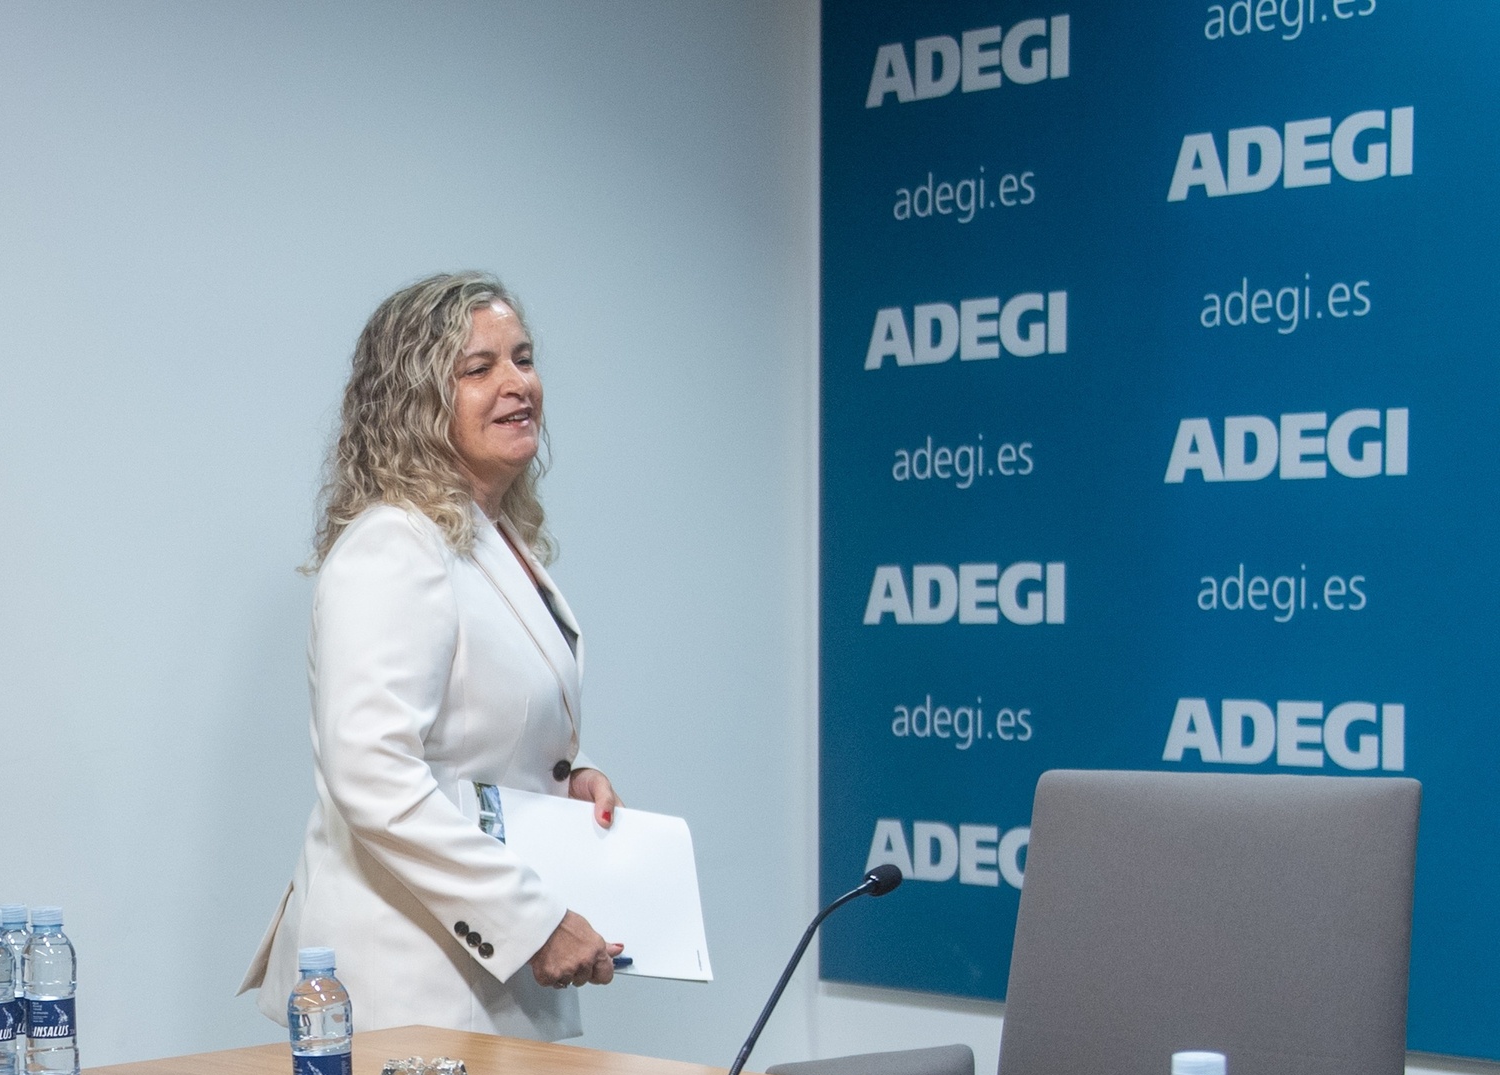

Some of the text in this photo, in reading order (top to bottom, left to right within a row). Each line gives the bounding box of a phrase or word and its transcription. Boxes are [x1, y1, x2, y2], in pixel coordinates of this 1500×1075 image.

[865, 13, 1071, 109] ADEGI
[1167, 105, 1415, 202] ADEGI
[892, 166, 1036, 224] adegi.es
[864, 290, 1068, 371] ADEGI
[1200, 272, 1372, 335] adegi.es
[891, 433, 1034, 489] adegi.es
[1164, 407, 1409, 484] ADEGI
[863, 561, 1066, 625] ADEGI
[1196, 562, 1368, 622] adegi.es
[891, 693, 1033, 750] adegi.es
[1162, 697, 1405, 771] ADEGI
[863, 817, 1032, 891] ADEG
[33, 1025, 69, 1037] INSALUS
